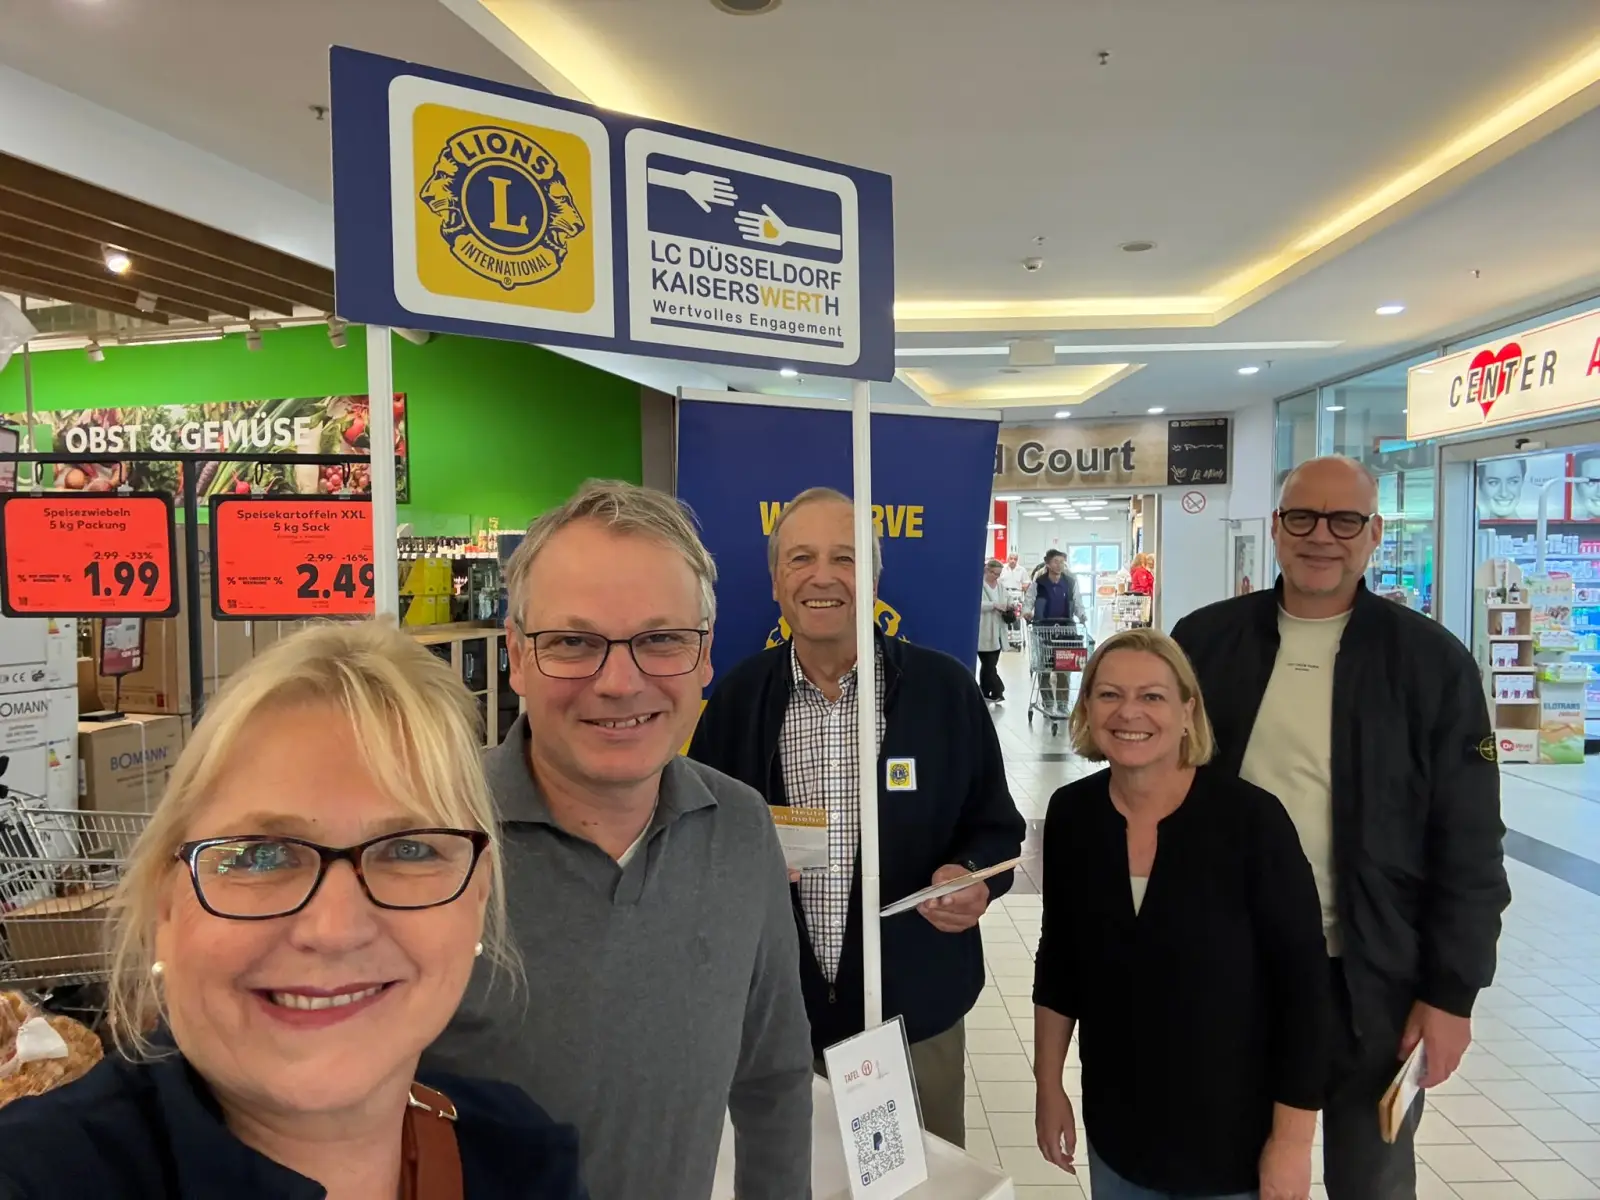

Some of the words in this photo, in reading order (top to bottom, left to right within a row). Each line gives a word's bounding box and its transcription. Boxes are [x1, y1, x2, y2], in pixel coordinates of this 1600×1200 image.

[456, 133, 550, 176] LIONS
[488, 176, 529, 235] L
[460, 240, 552, 277] INTERNATIONAL
[651, 239, 681, 265] LC
[689, 245, 842, 291] DÜSSELDORF
[652, 268, 840, 317] KAISERSWERTH
[653, 299, 743, 324] Wertvolles
[749, 313, 842, 337] Engagement
[1449, 350, 1558, 408] CENTER
[65, 424, 141, 453] OBST
[150, 423, 172, 452] &
[180, 411, 312, 450] GEMÜSE
[1017, 439, 1136, 474] Court
[43, 507, 131, 522] Speisezwiebeln
[50, 520, 57, 530] 5
[60, 520, 74, 532] kg
[77, 520, 126, 532] Packung
[237, 509, 338, 521] Speisekartoffeln
[341, 510, 366, 520] XXL
[273, 522, 281, 532] 5
[284, 522, 299, 534] kg
[302, 522, 330, 532] Sack
[871, 505, 924, 538] RVE
[125, 551, 153, 560] -33%
[306, 553, 334, 562] 2.99
[342, 553, 368, 562] -16%
[84, 561, 159, 597] 1.99
[296, 563, 374, 599] 2.49
[110, 747, 167, 771] BOMANN
[844, 1069, 860, 1084] TAFEL
